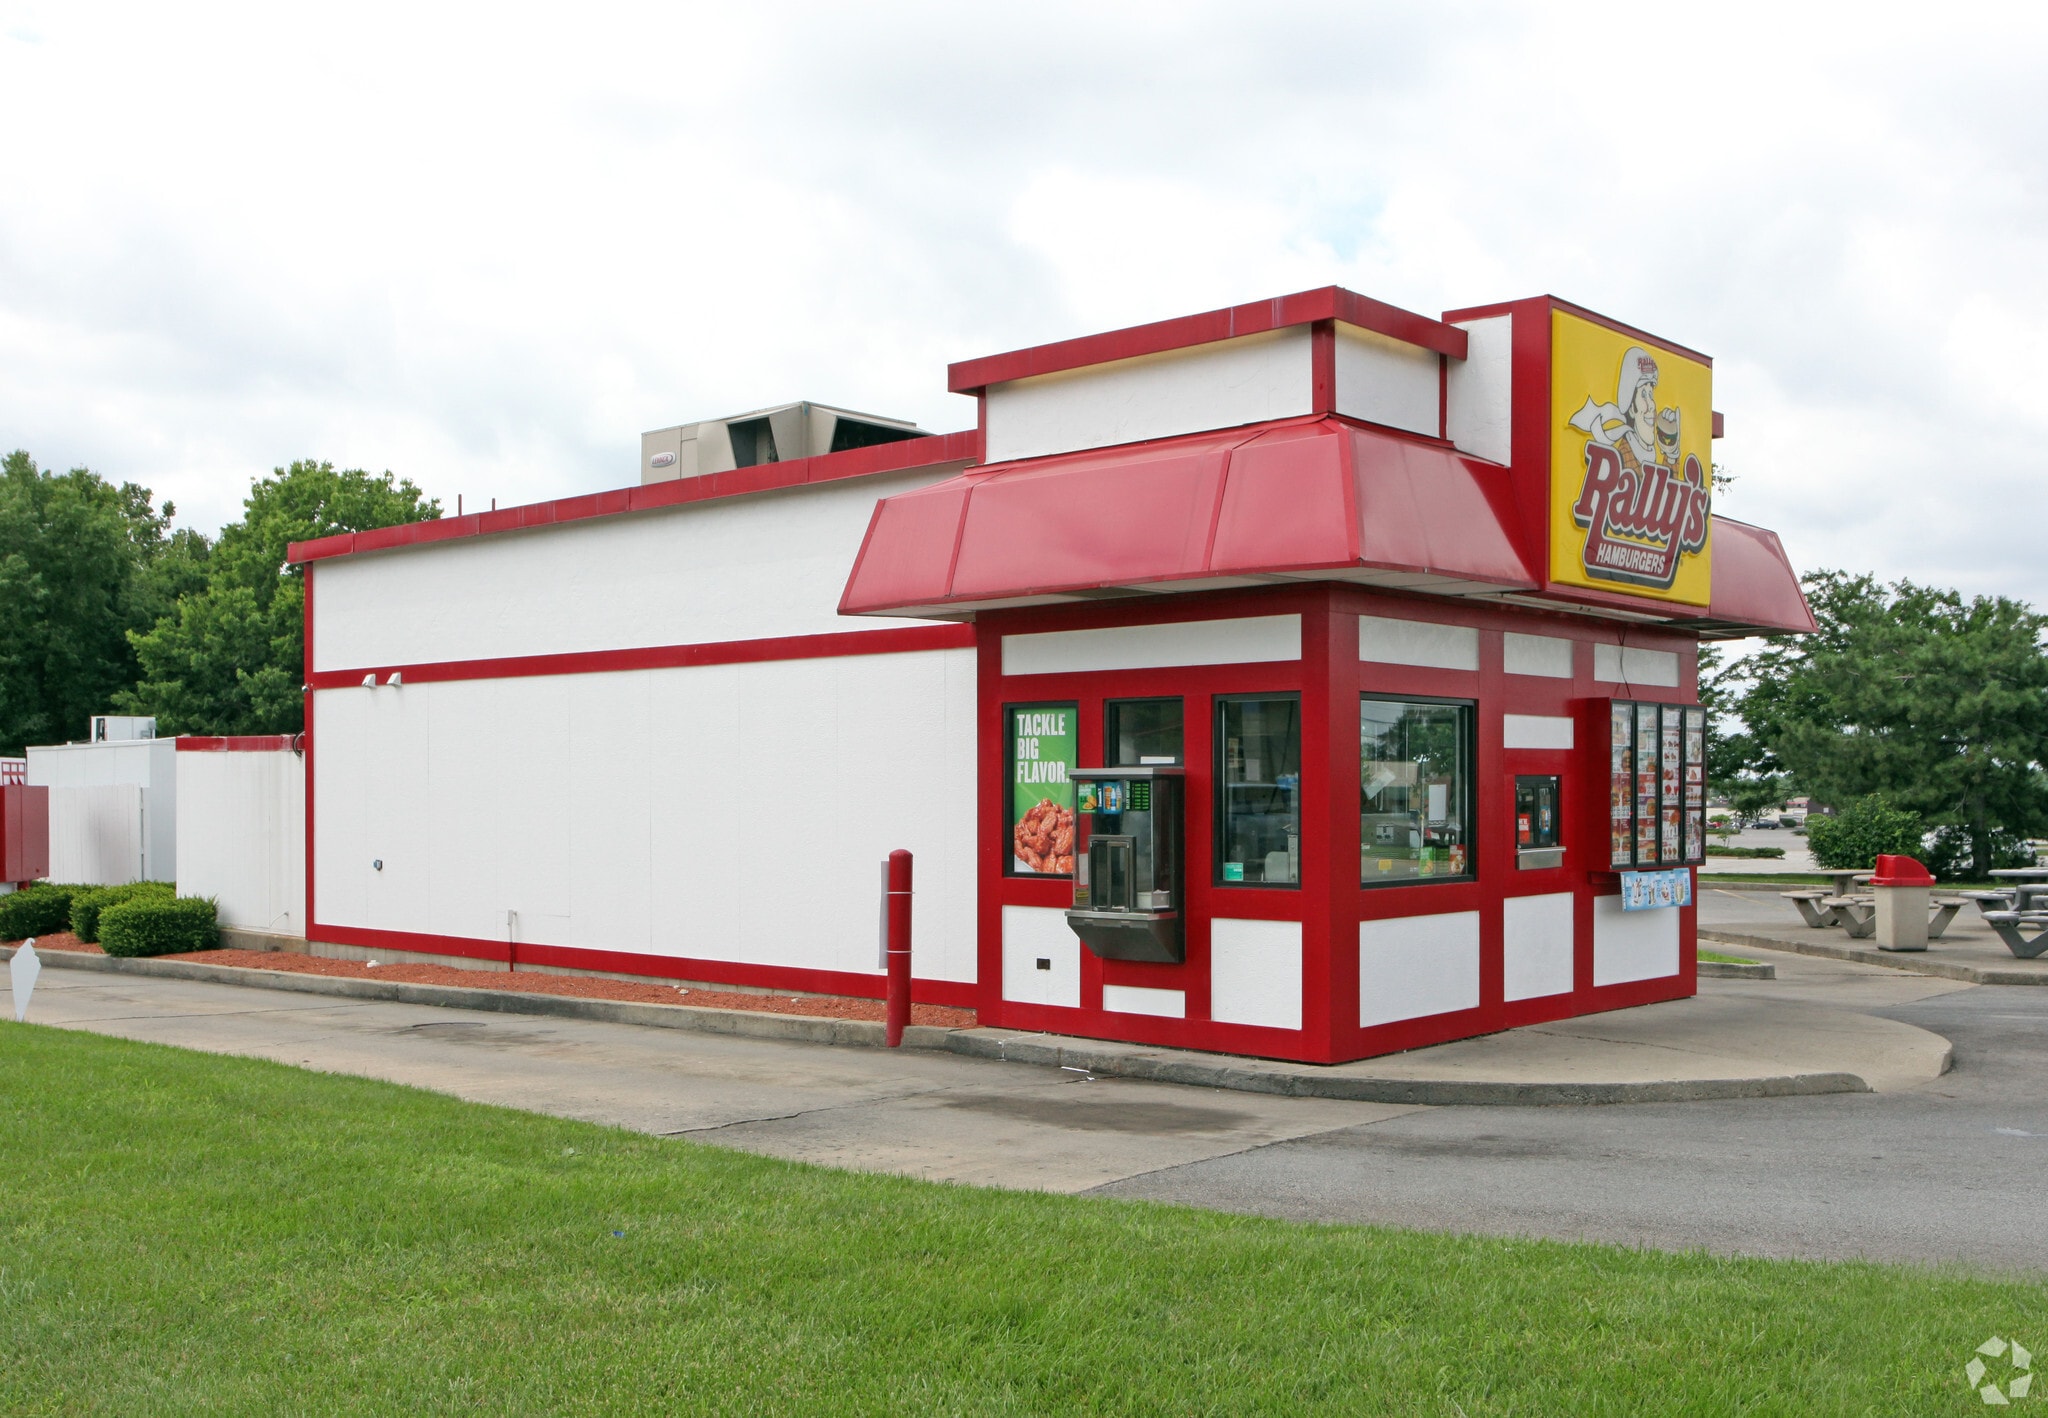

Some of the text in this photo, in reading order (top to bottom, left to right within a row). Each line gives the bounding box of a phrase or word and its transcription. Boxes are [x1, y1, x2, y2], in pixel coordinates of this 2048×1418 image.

[1574, 442, 1708, 546] Rally's
[1596, 542, 1665, 575] HAMBURGERS
[1016, 713, 1066, 736] TACKLE
[1017, 737, 1039, 760] BIG
[1016, 761, 1070, 784] FLAVOR.
